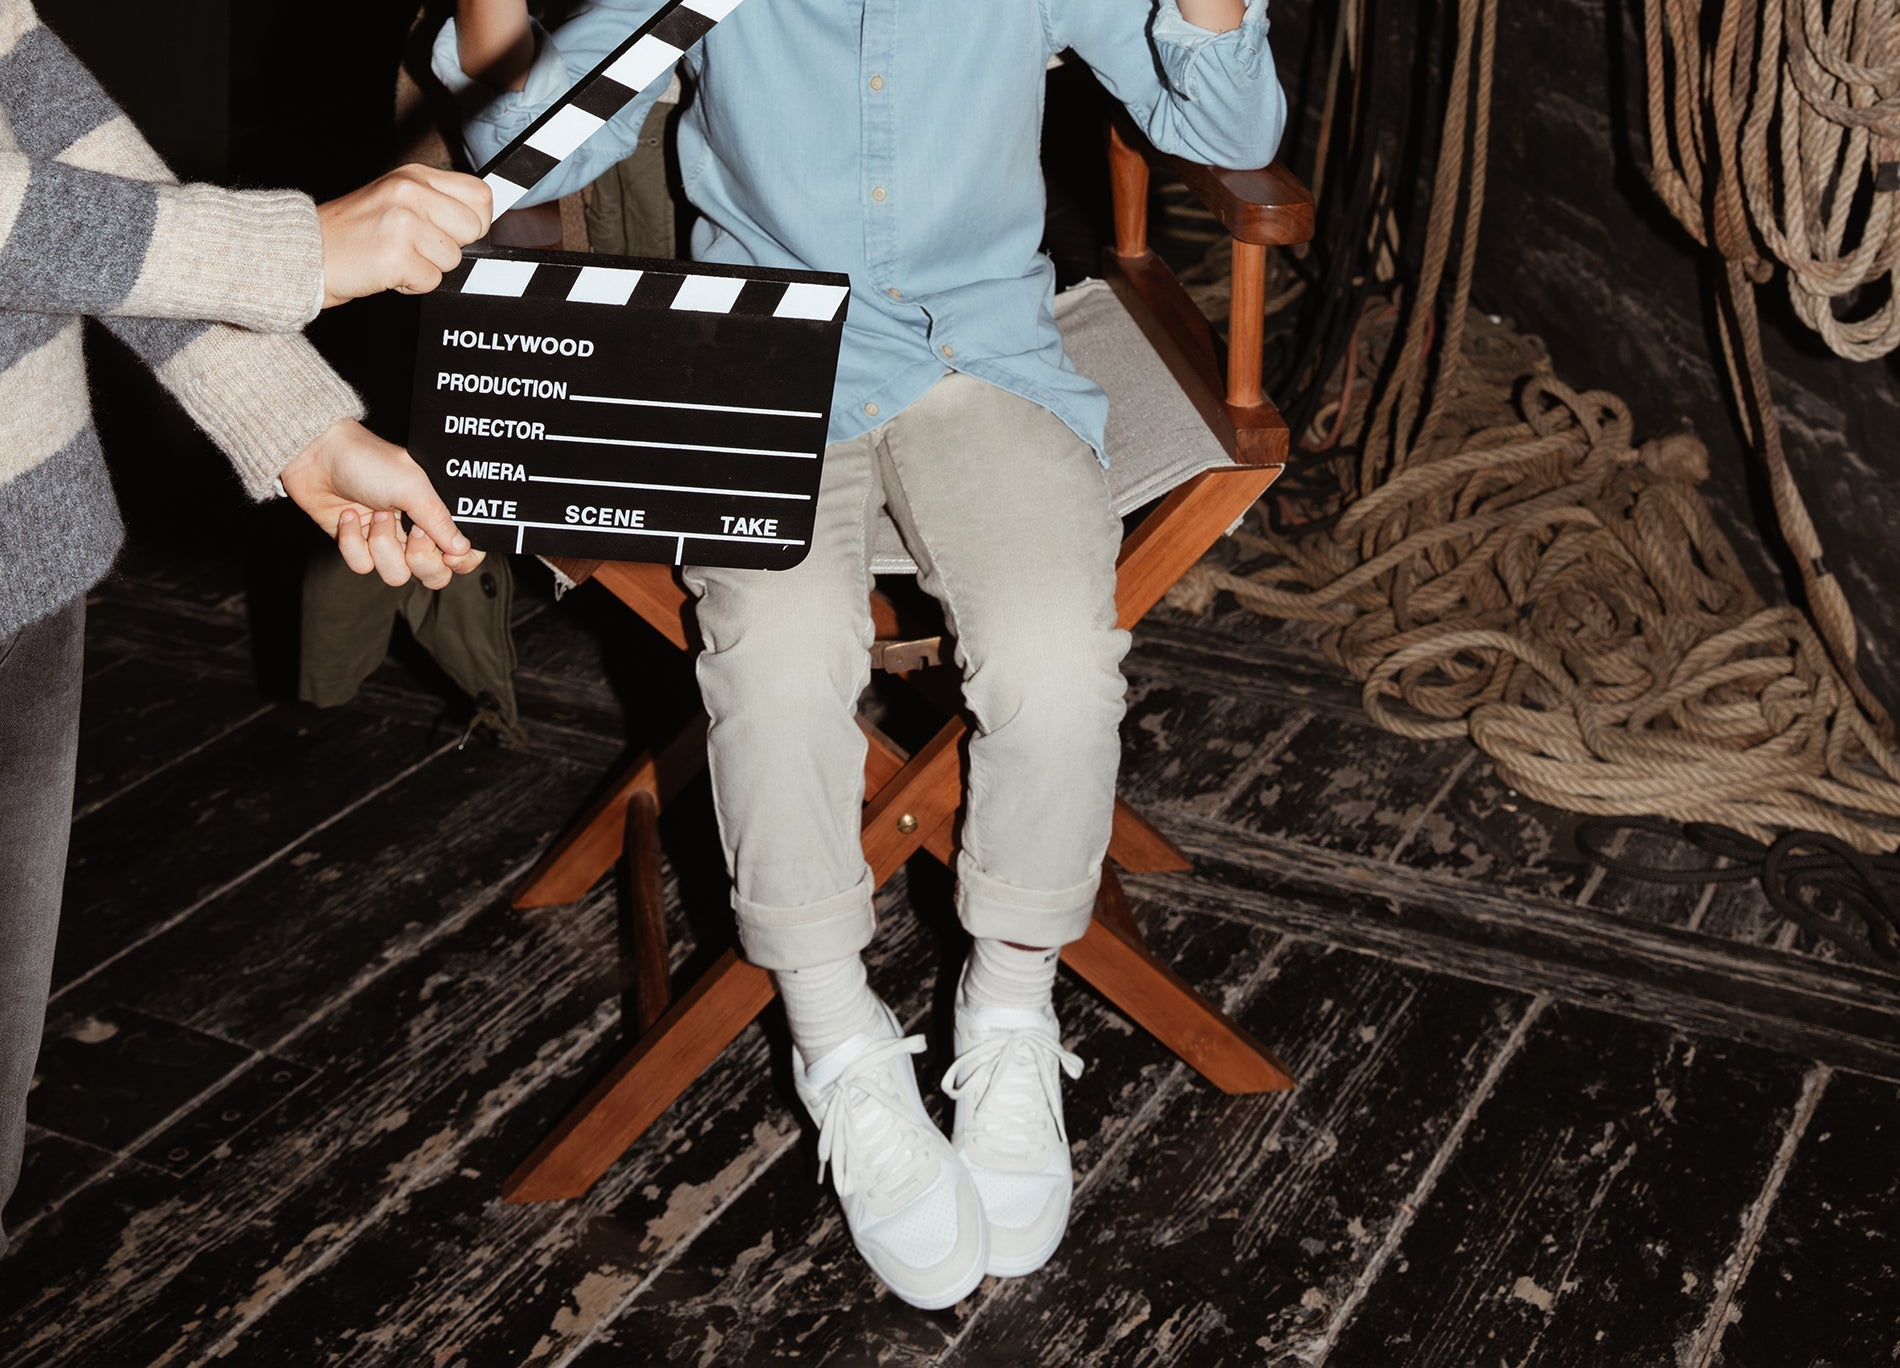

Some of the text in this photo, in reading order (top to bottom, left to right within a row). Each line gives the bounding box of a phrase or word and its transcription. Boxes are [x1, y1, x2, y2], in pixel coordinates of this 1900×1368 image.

[443, 330, 594, 357] HOLLYWOOD
[437, 372, 567, 399] PRODUCTION
[445, 416, 544, 440] DIRECTOR
[446, 459, 526, 481] CAMERA
[457, 498, 778, 537] DATE SCENE TAKE
